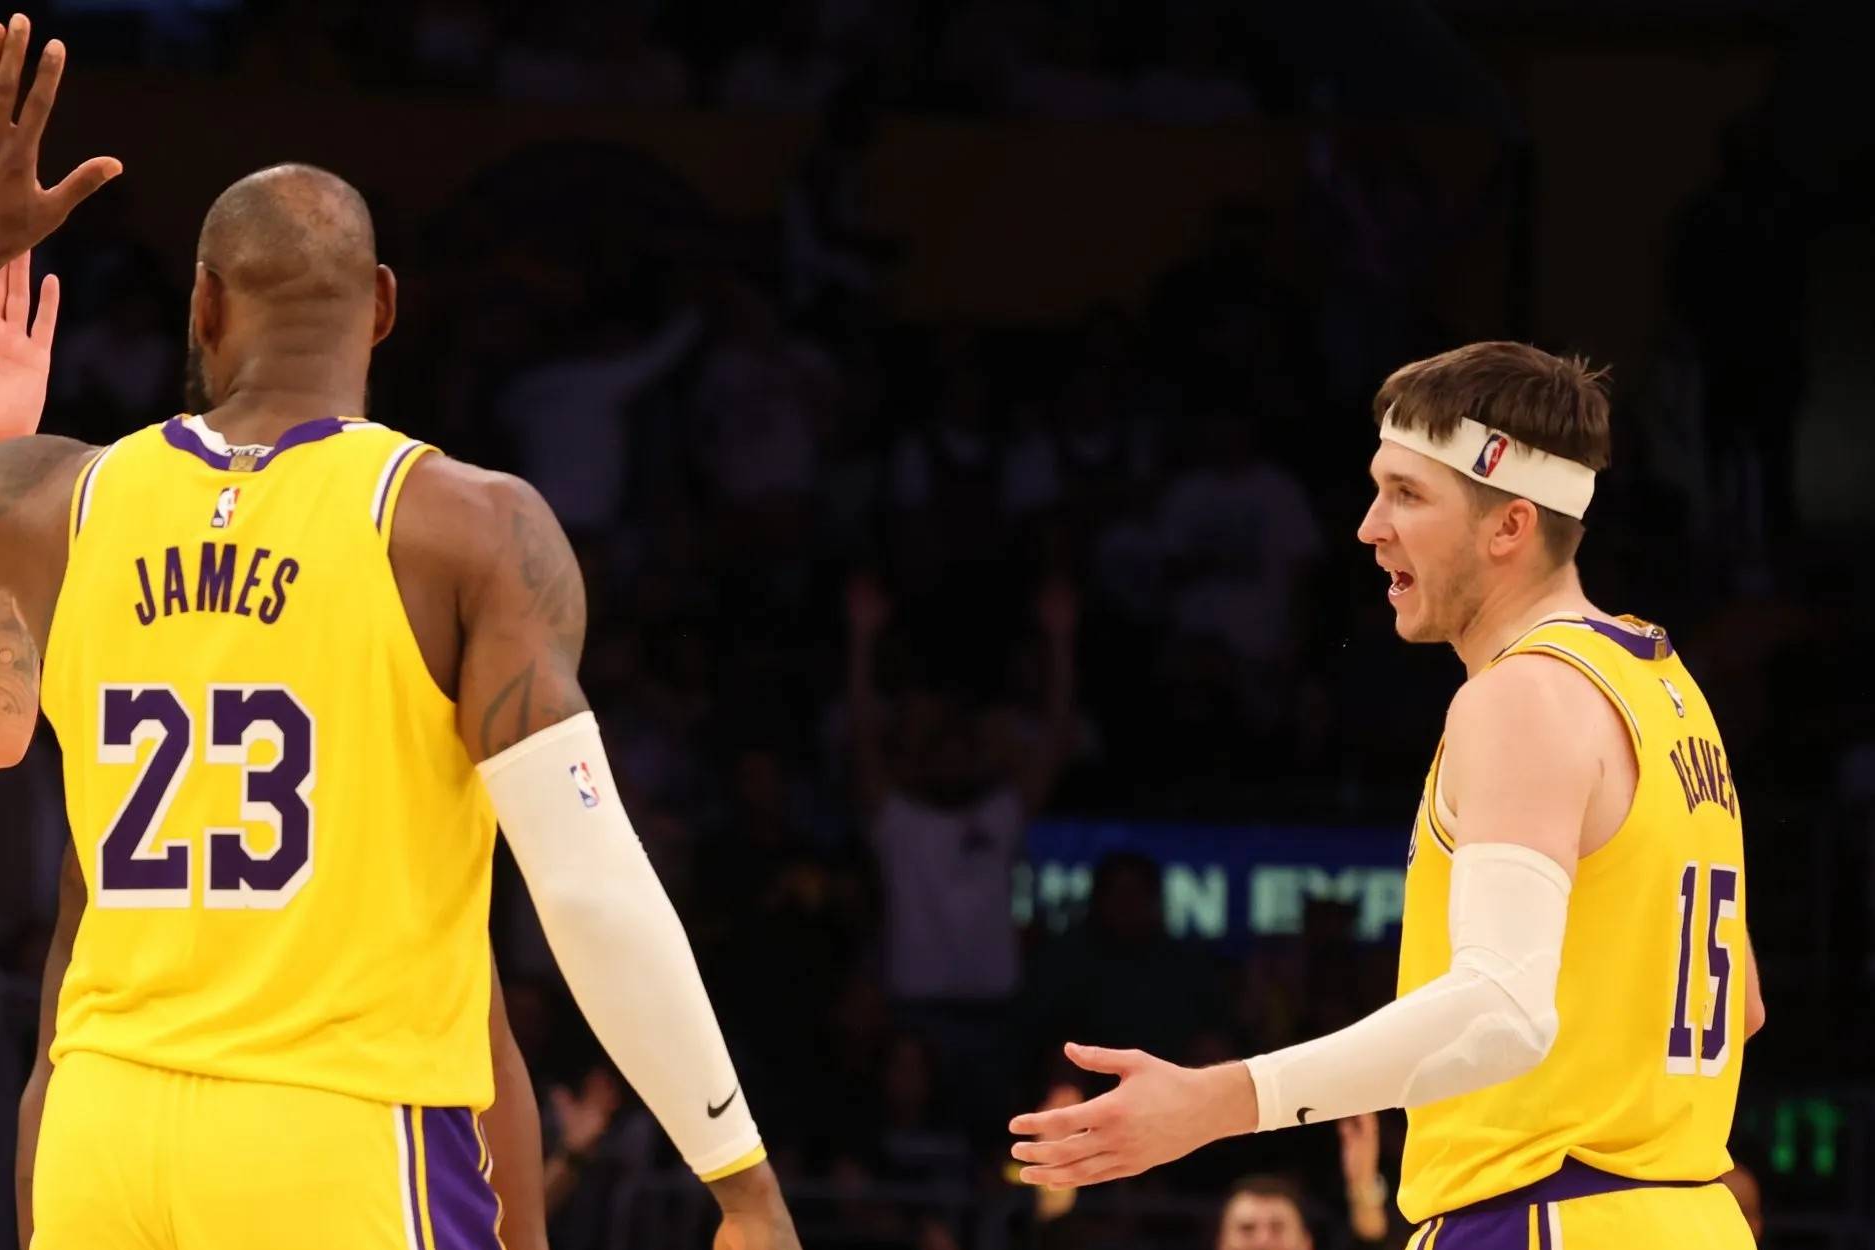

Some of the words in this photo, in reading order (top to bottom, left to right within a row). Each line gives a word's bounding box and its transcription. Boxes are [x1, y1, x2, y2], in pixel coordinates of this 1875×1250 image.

[134, 541, 300, 627] JAMES
[98, 685, 316, 907] 23
[1665, 860, 1739, 1078] 15
